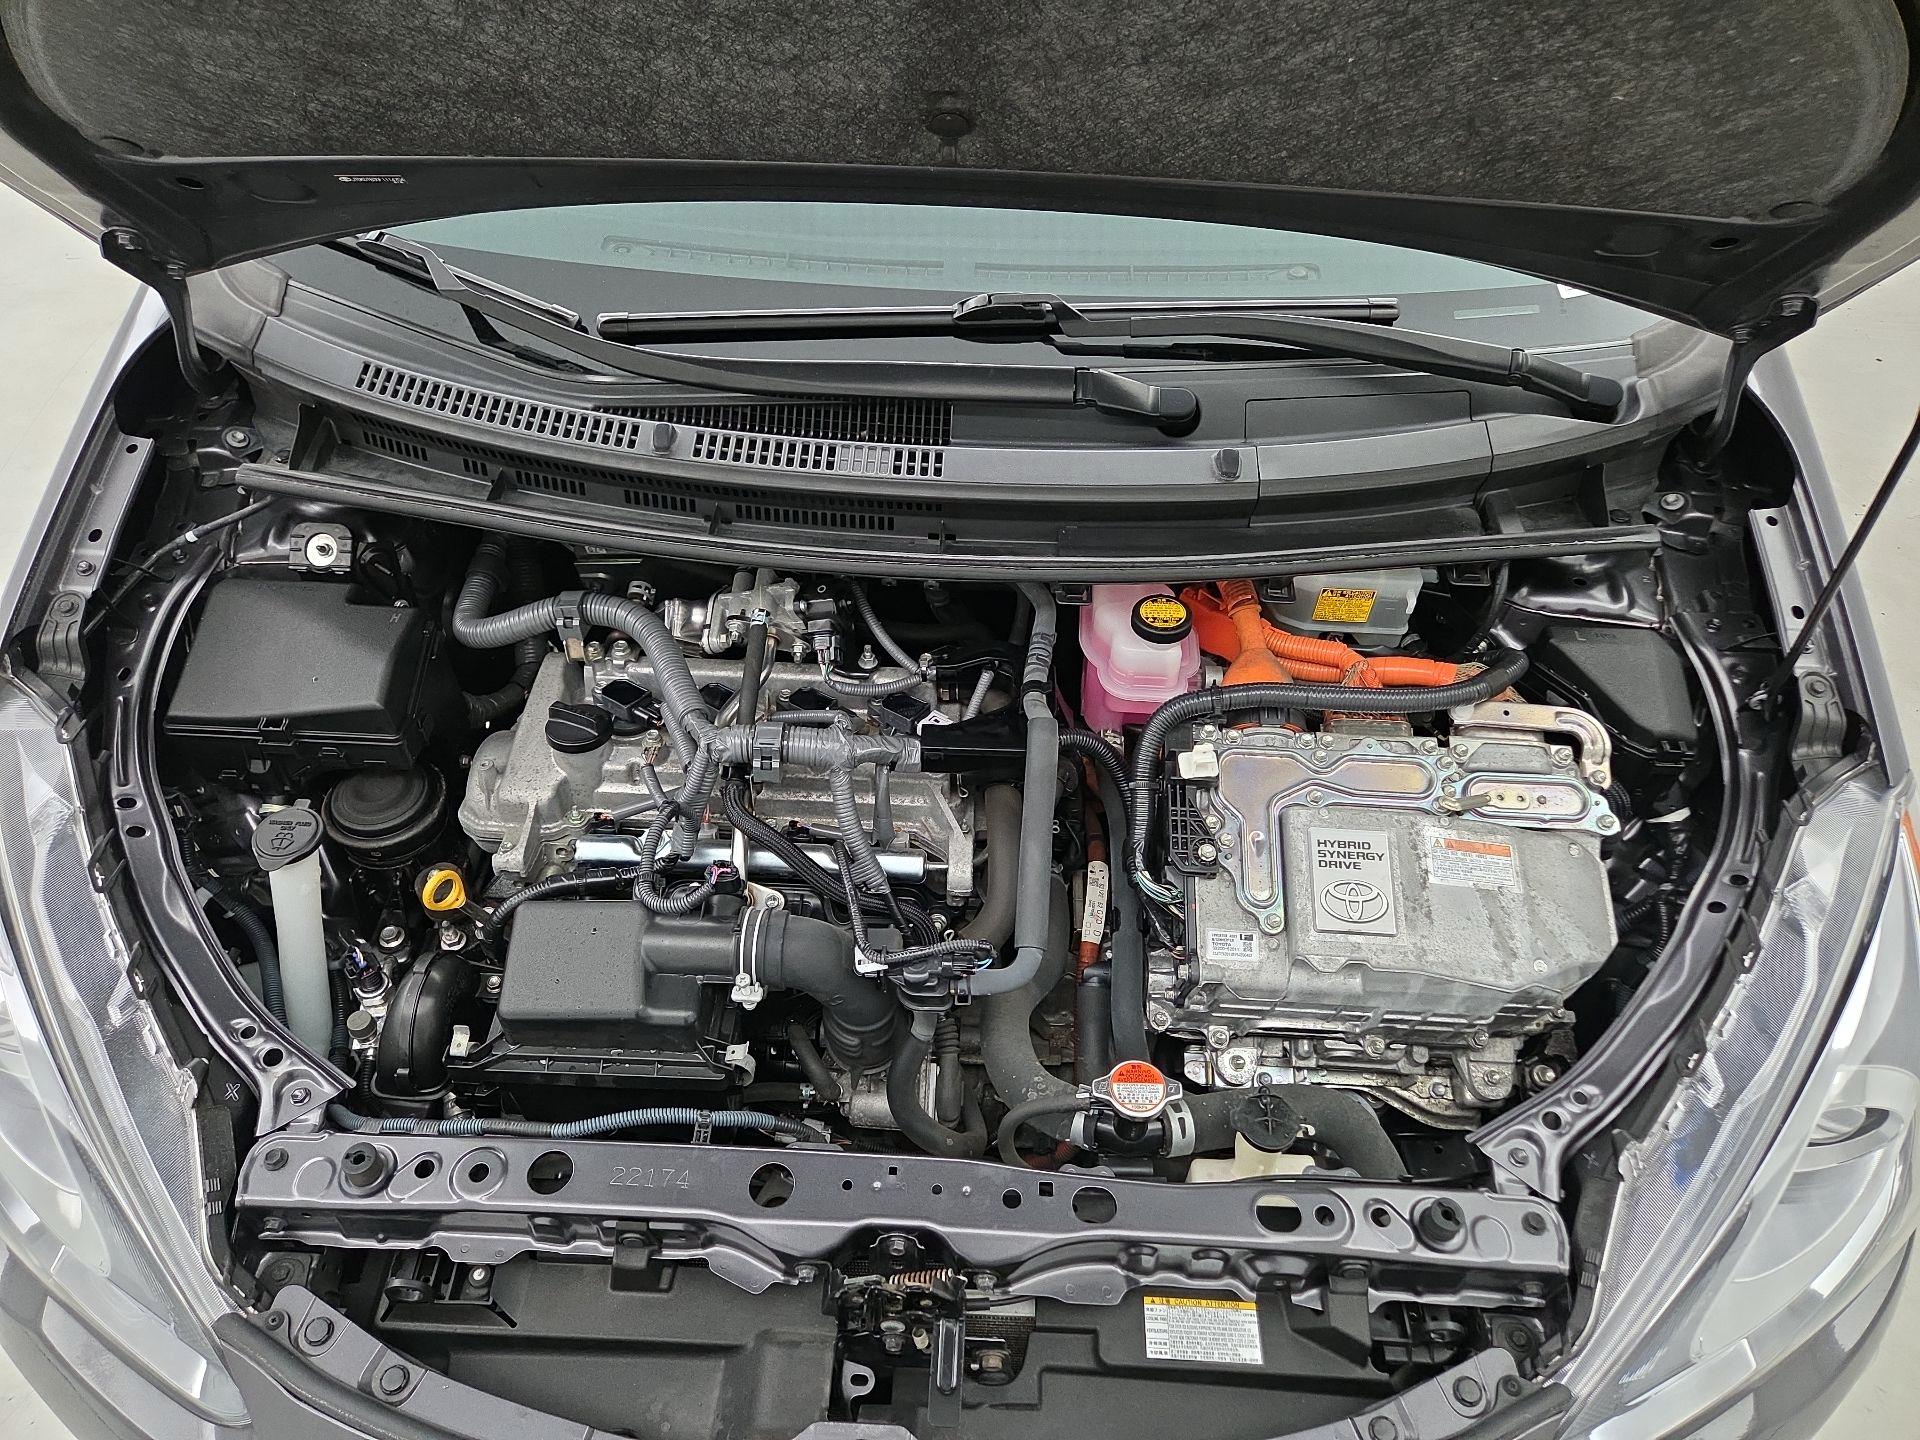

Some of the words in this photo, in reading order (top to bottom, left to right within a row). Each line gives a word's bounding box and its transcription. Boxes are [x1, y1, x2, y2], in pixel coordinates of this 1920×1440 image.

[1317, 839, 1371, 850] HYBRID
[1317, 850, 1385, 862] SYNERGY
[1318, 859, 1362, 870] DRIVE
[609, 1166, 690, 1189] 22174
[1175, 1298, 1202, 1306] CAUTION
[1206, 1300, 1240, 1308] ATTENTION
